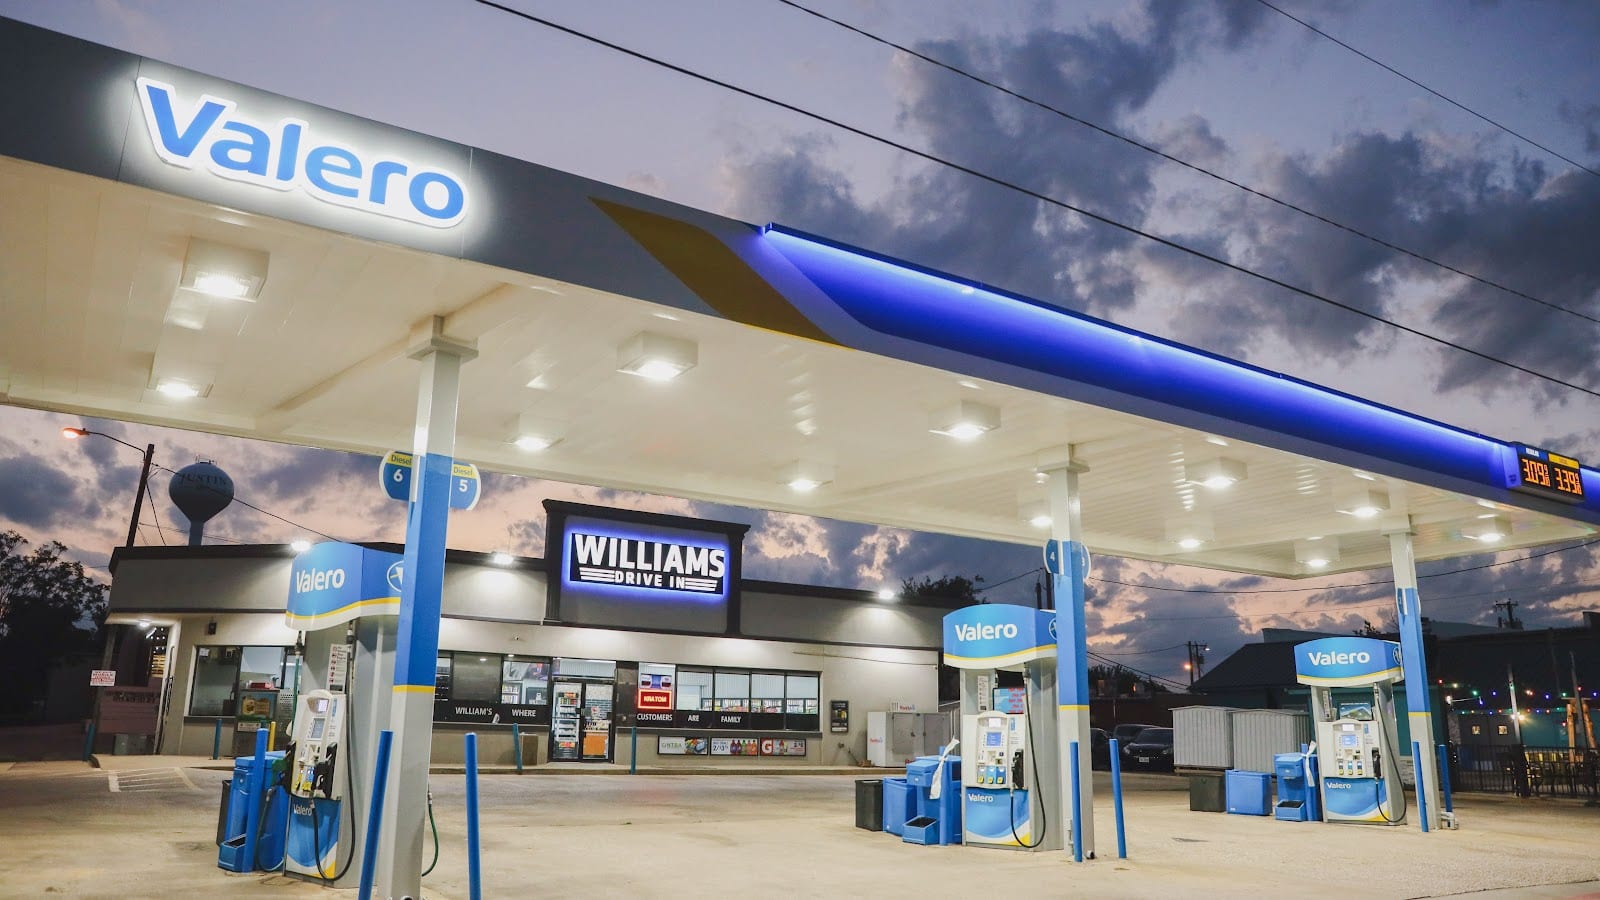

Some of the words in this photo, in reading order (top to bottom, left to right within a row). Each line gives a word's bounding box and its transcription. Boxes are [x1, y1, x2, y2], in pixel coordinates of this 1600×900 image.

[146, 84, 464, 219] Valero
[391, 454, 412, 465] Diesel
[393, 469, 403, 482] 6
[453, 466, 472, 476] Diesel
[459, 479, 468, 492] 5
[574, 534, 725, 578] WILLIAMS
[1050, 551, 1056, 561] 4
[296, 567, 345, 593] Valero
[614, 570, 663, 587] DRIVE
[669, 575, 686, 589] IN
[955, 622, 1018, 642] Valero
[1308, 650, 1370, 666] Valero
[455, 707, 493, 715] WILLIAM'S
[512, 709, 536, 717] WHERE
[636, 713, 673, 721] CUSTOMERS
[688, 714, 700, 722] ARE
[762, 740, 773, 754] G
[968, 793, 993, 803] Valero
[293, 803, 312, 816] Valero
